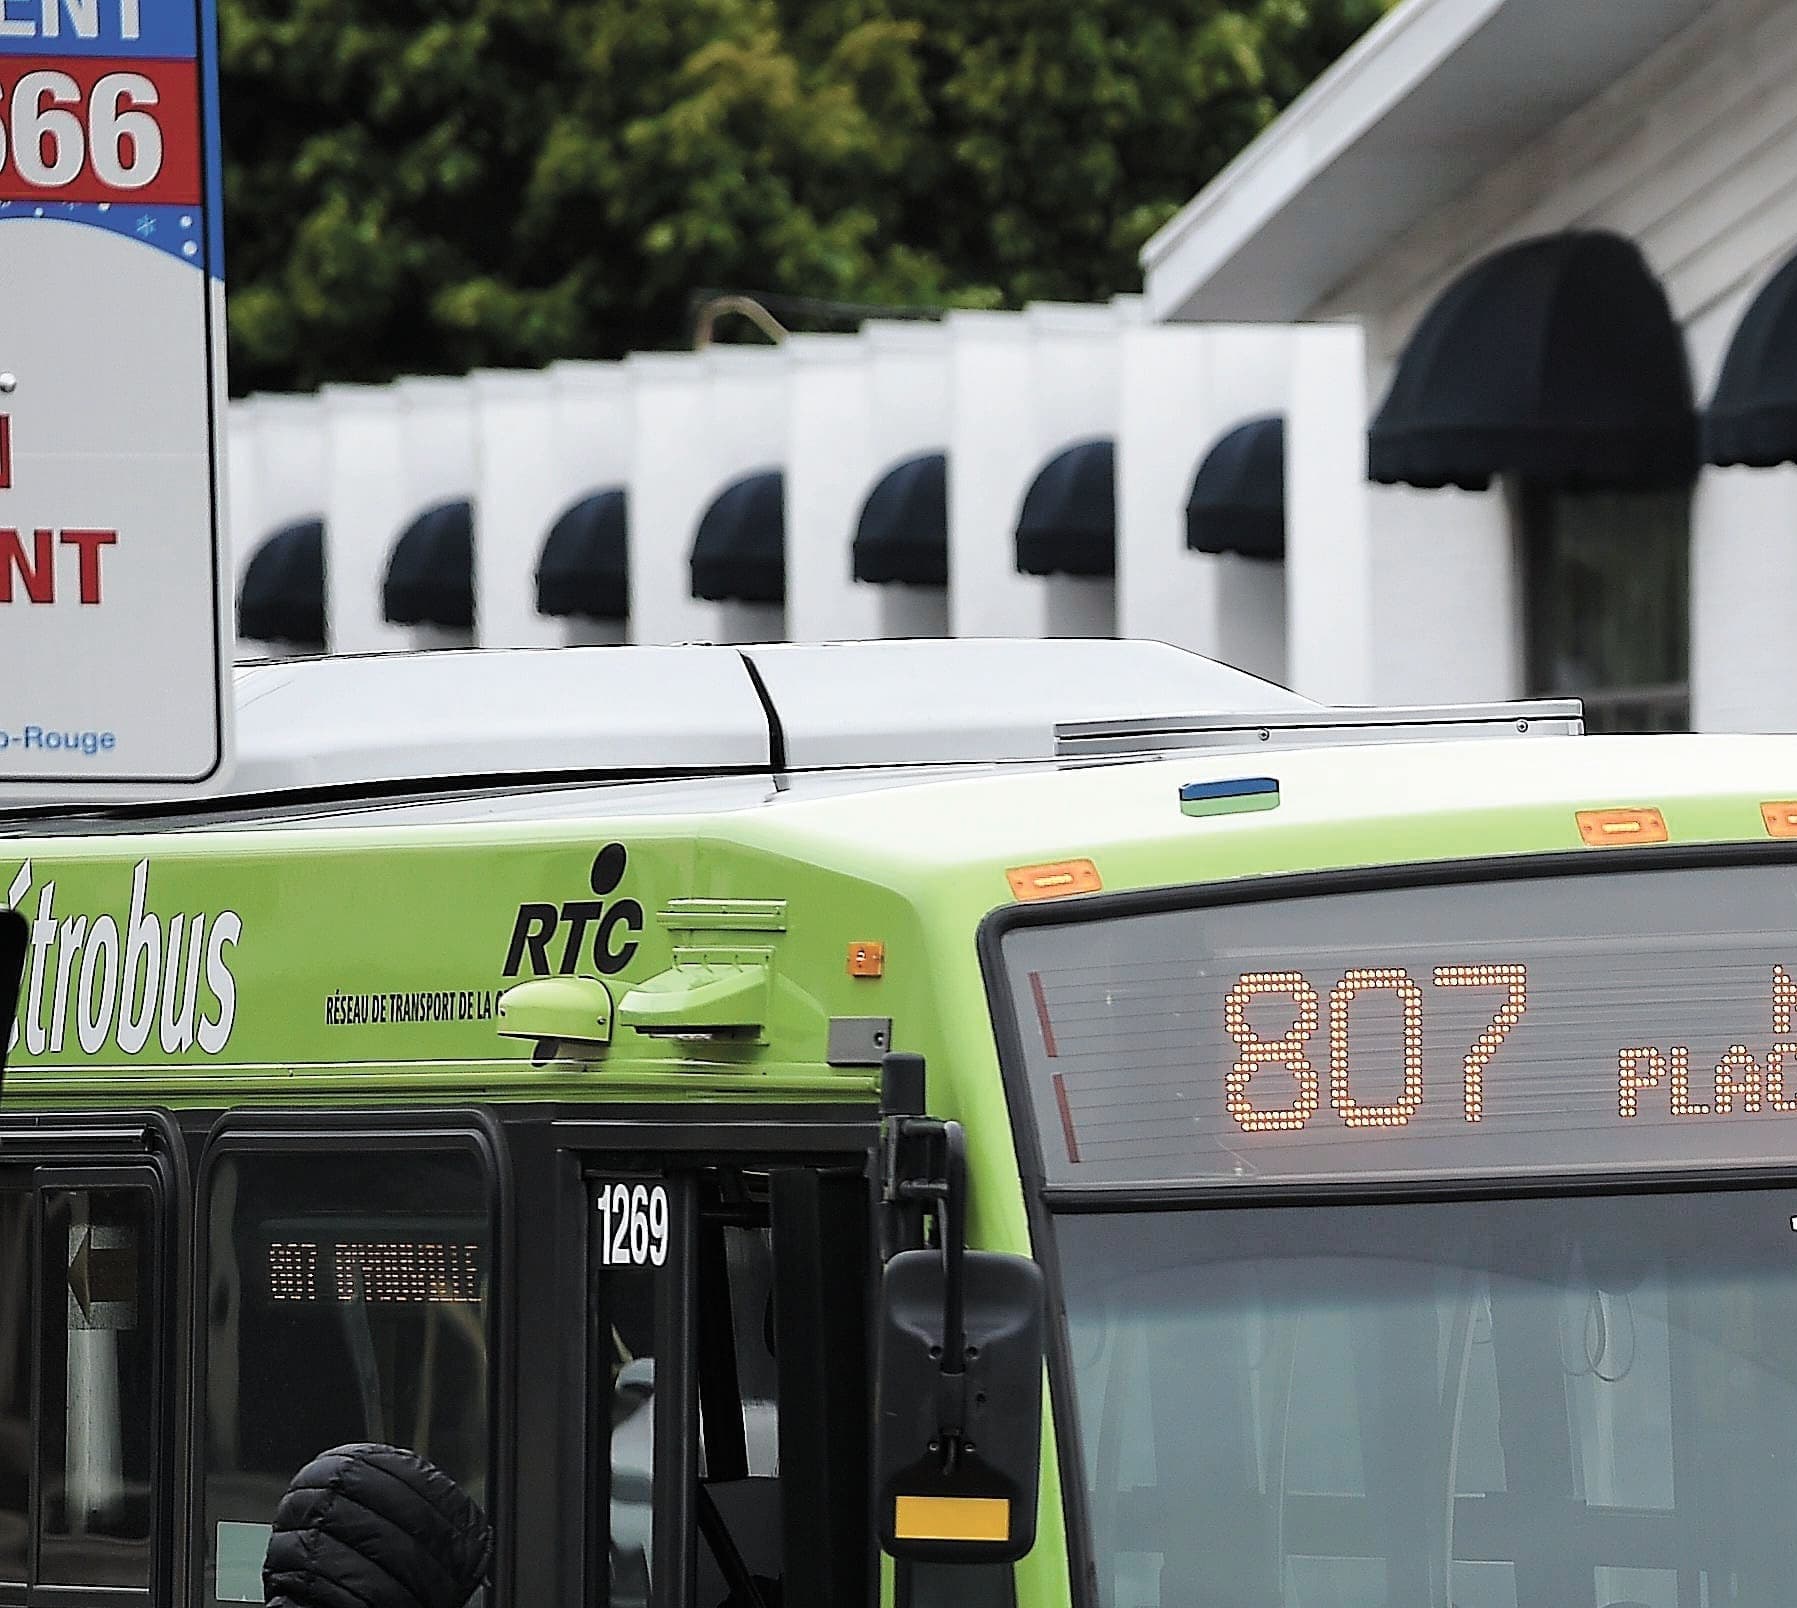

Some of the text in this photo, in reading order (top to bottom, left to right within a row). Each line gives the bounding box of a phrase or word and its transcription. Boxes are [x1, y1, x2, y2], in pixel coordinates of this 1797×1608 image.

[0, 69, 163, 188] 66
[8, 857, 243, 1055] trobus
[502, 898, 643, 977] RTC
[326, 988, 369, 1025] RÉSEAU
[371, 994, 387, 1022] DE
[389, 991, 457, 1022] TRANSPORT
[458, 991, 474, 1020] DE
[477, 990, 492, 1020] LA
[1223, 963, 1527, 1132] 807
[598, 1183, 668, 1267] 1269
